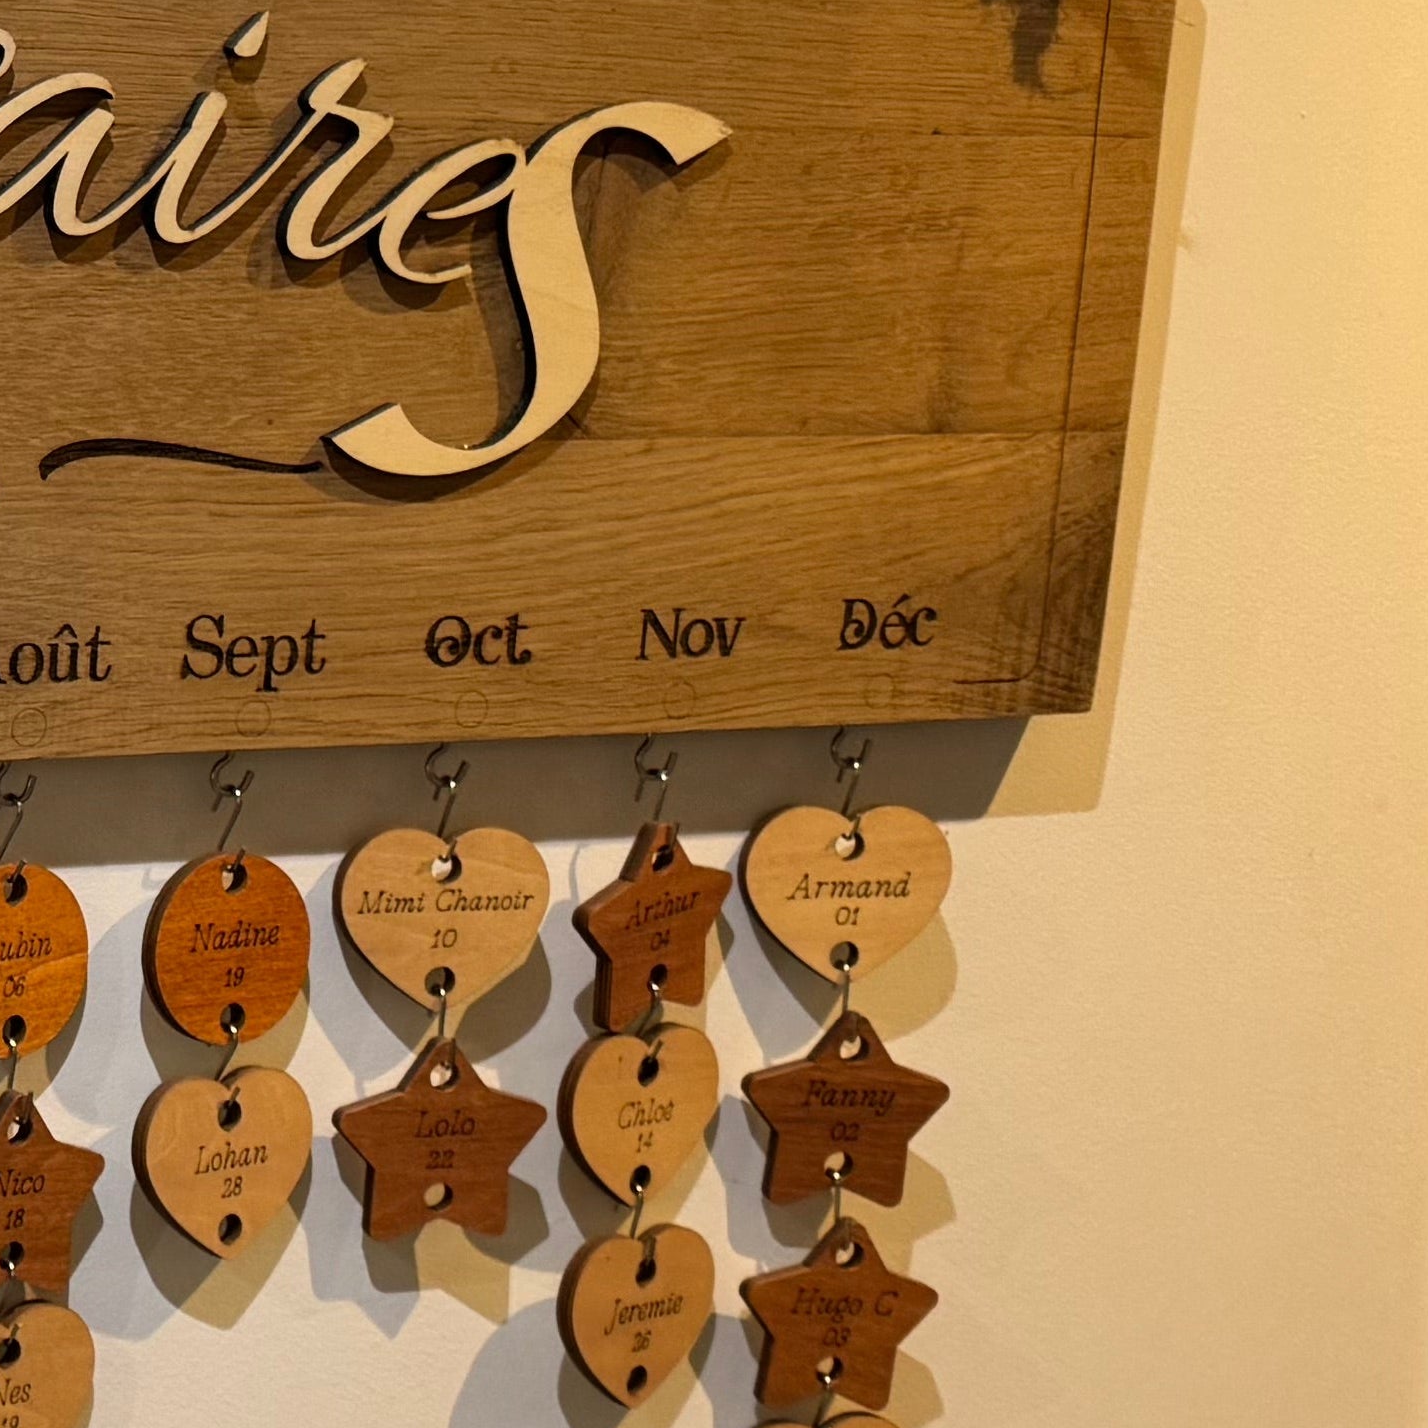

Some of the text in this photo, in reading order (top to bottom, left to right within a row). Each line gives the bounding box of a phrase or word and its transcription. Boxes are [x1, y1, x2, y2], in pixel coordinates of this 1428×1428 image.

[179, 613, 326, 691] Sept
[424, 613, 532, 668] Oct
[638, 606, 745, 660] Nov
[836, 594, 938, 652] Déc
[787, 872, 911, 901] Armand
[357, 889, 536, 915] Mimi Chanoir
[625, 890, 701, 931] Arthur
[835, 906, 860, 926] 01
[189, 921, 280, 953] Nadine
[431, 928, 457, 949] 10
[2, 975, 26, 998] 06
[223, 966, 245, 987] 19
[803, 1080, 897, 1115] Fanny
[415, 1110, 477, 1138] Lolo
[831, 1122, 859, 1142] 02
[636, 1133, 654, 1154] 14
[193, 1141, 269, 1176] Lohan
[426, 1150, 454, 1170] 22
[221, 1176, 243, 1197] 28
[3, 1208, 25, 1230] 18
[790, 1287, 898, 1324] Hugo C
